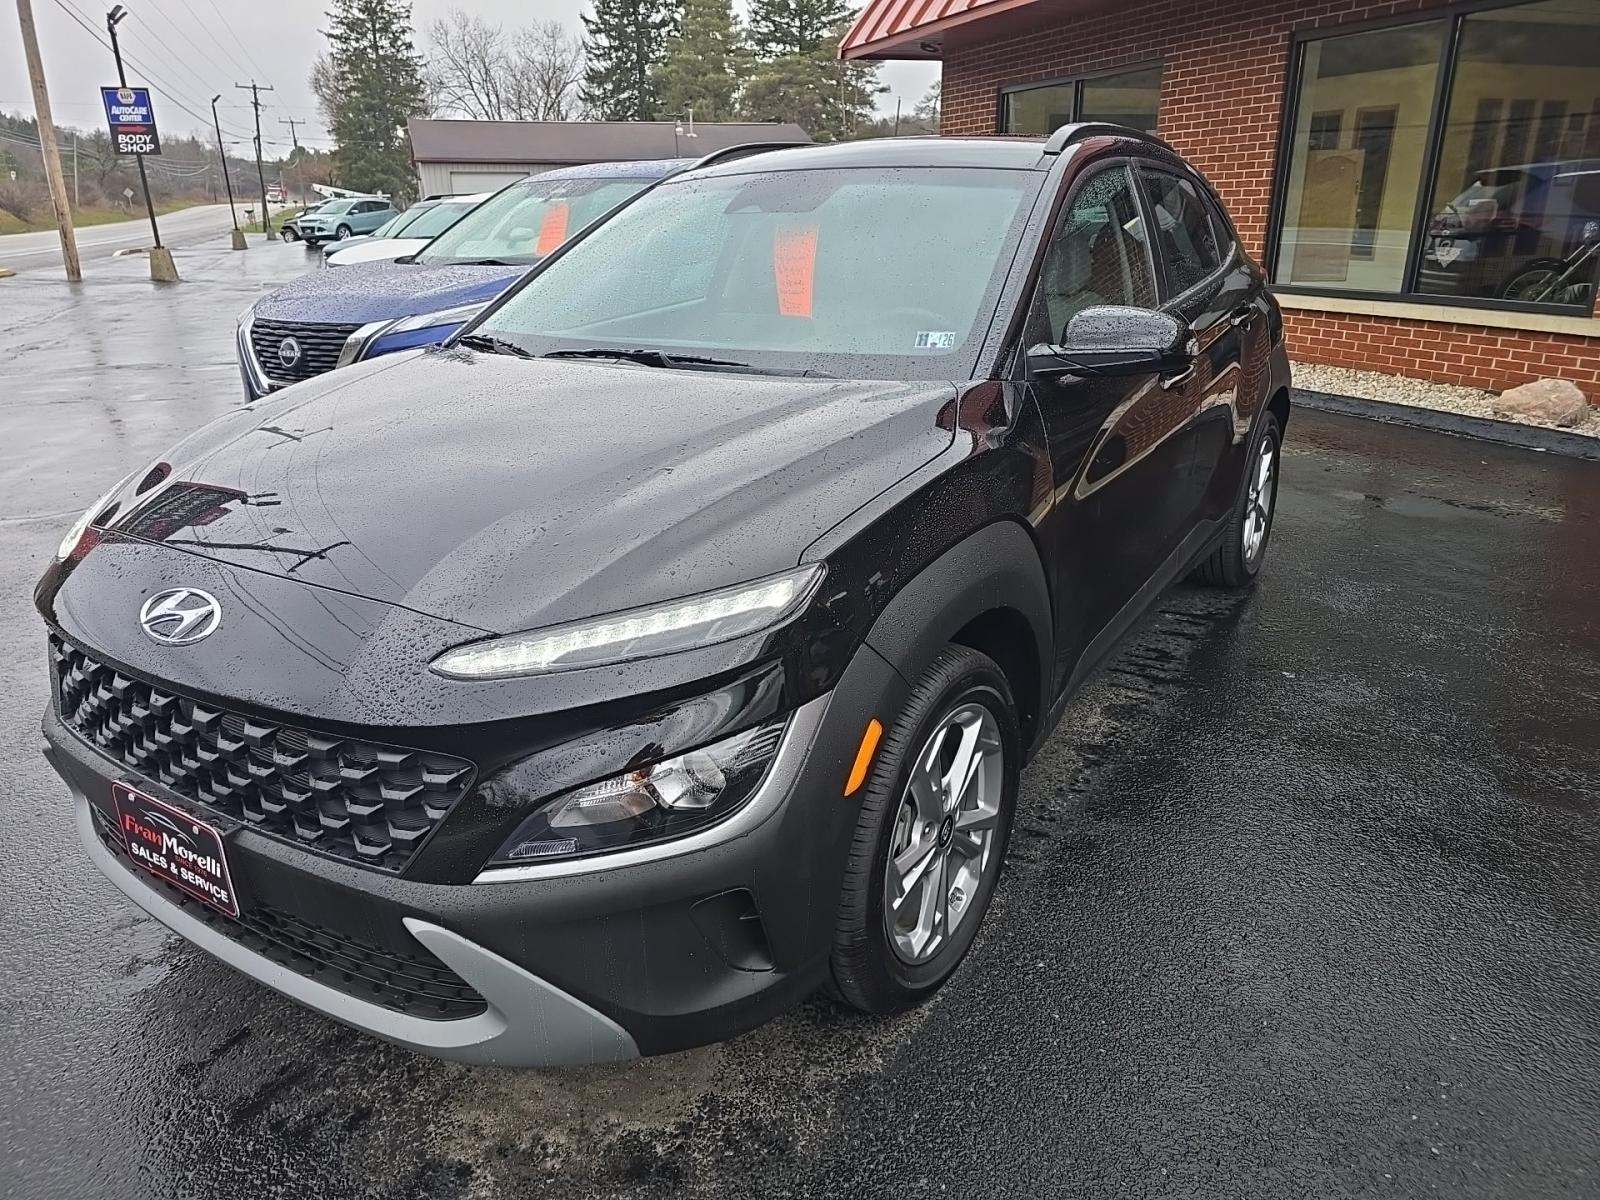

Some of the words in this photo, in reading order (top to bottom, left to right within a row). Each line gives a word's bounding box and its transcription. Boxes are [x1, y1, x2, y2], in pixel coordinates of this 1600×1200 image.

[119, 114, 143, 122] CENTER
[118, 134, 152, 143] BODY
[119, 144, 155, 153] SHOP
[943, 333, 954, 346] 26
[131, 842, 168, 869] SALES
[170, 862, 179, 875] &
[180, 867, 229, 903] SERVICE
